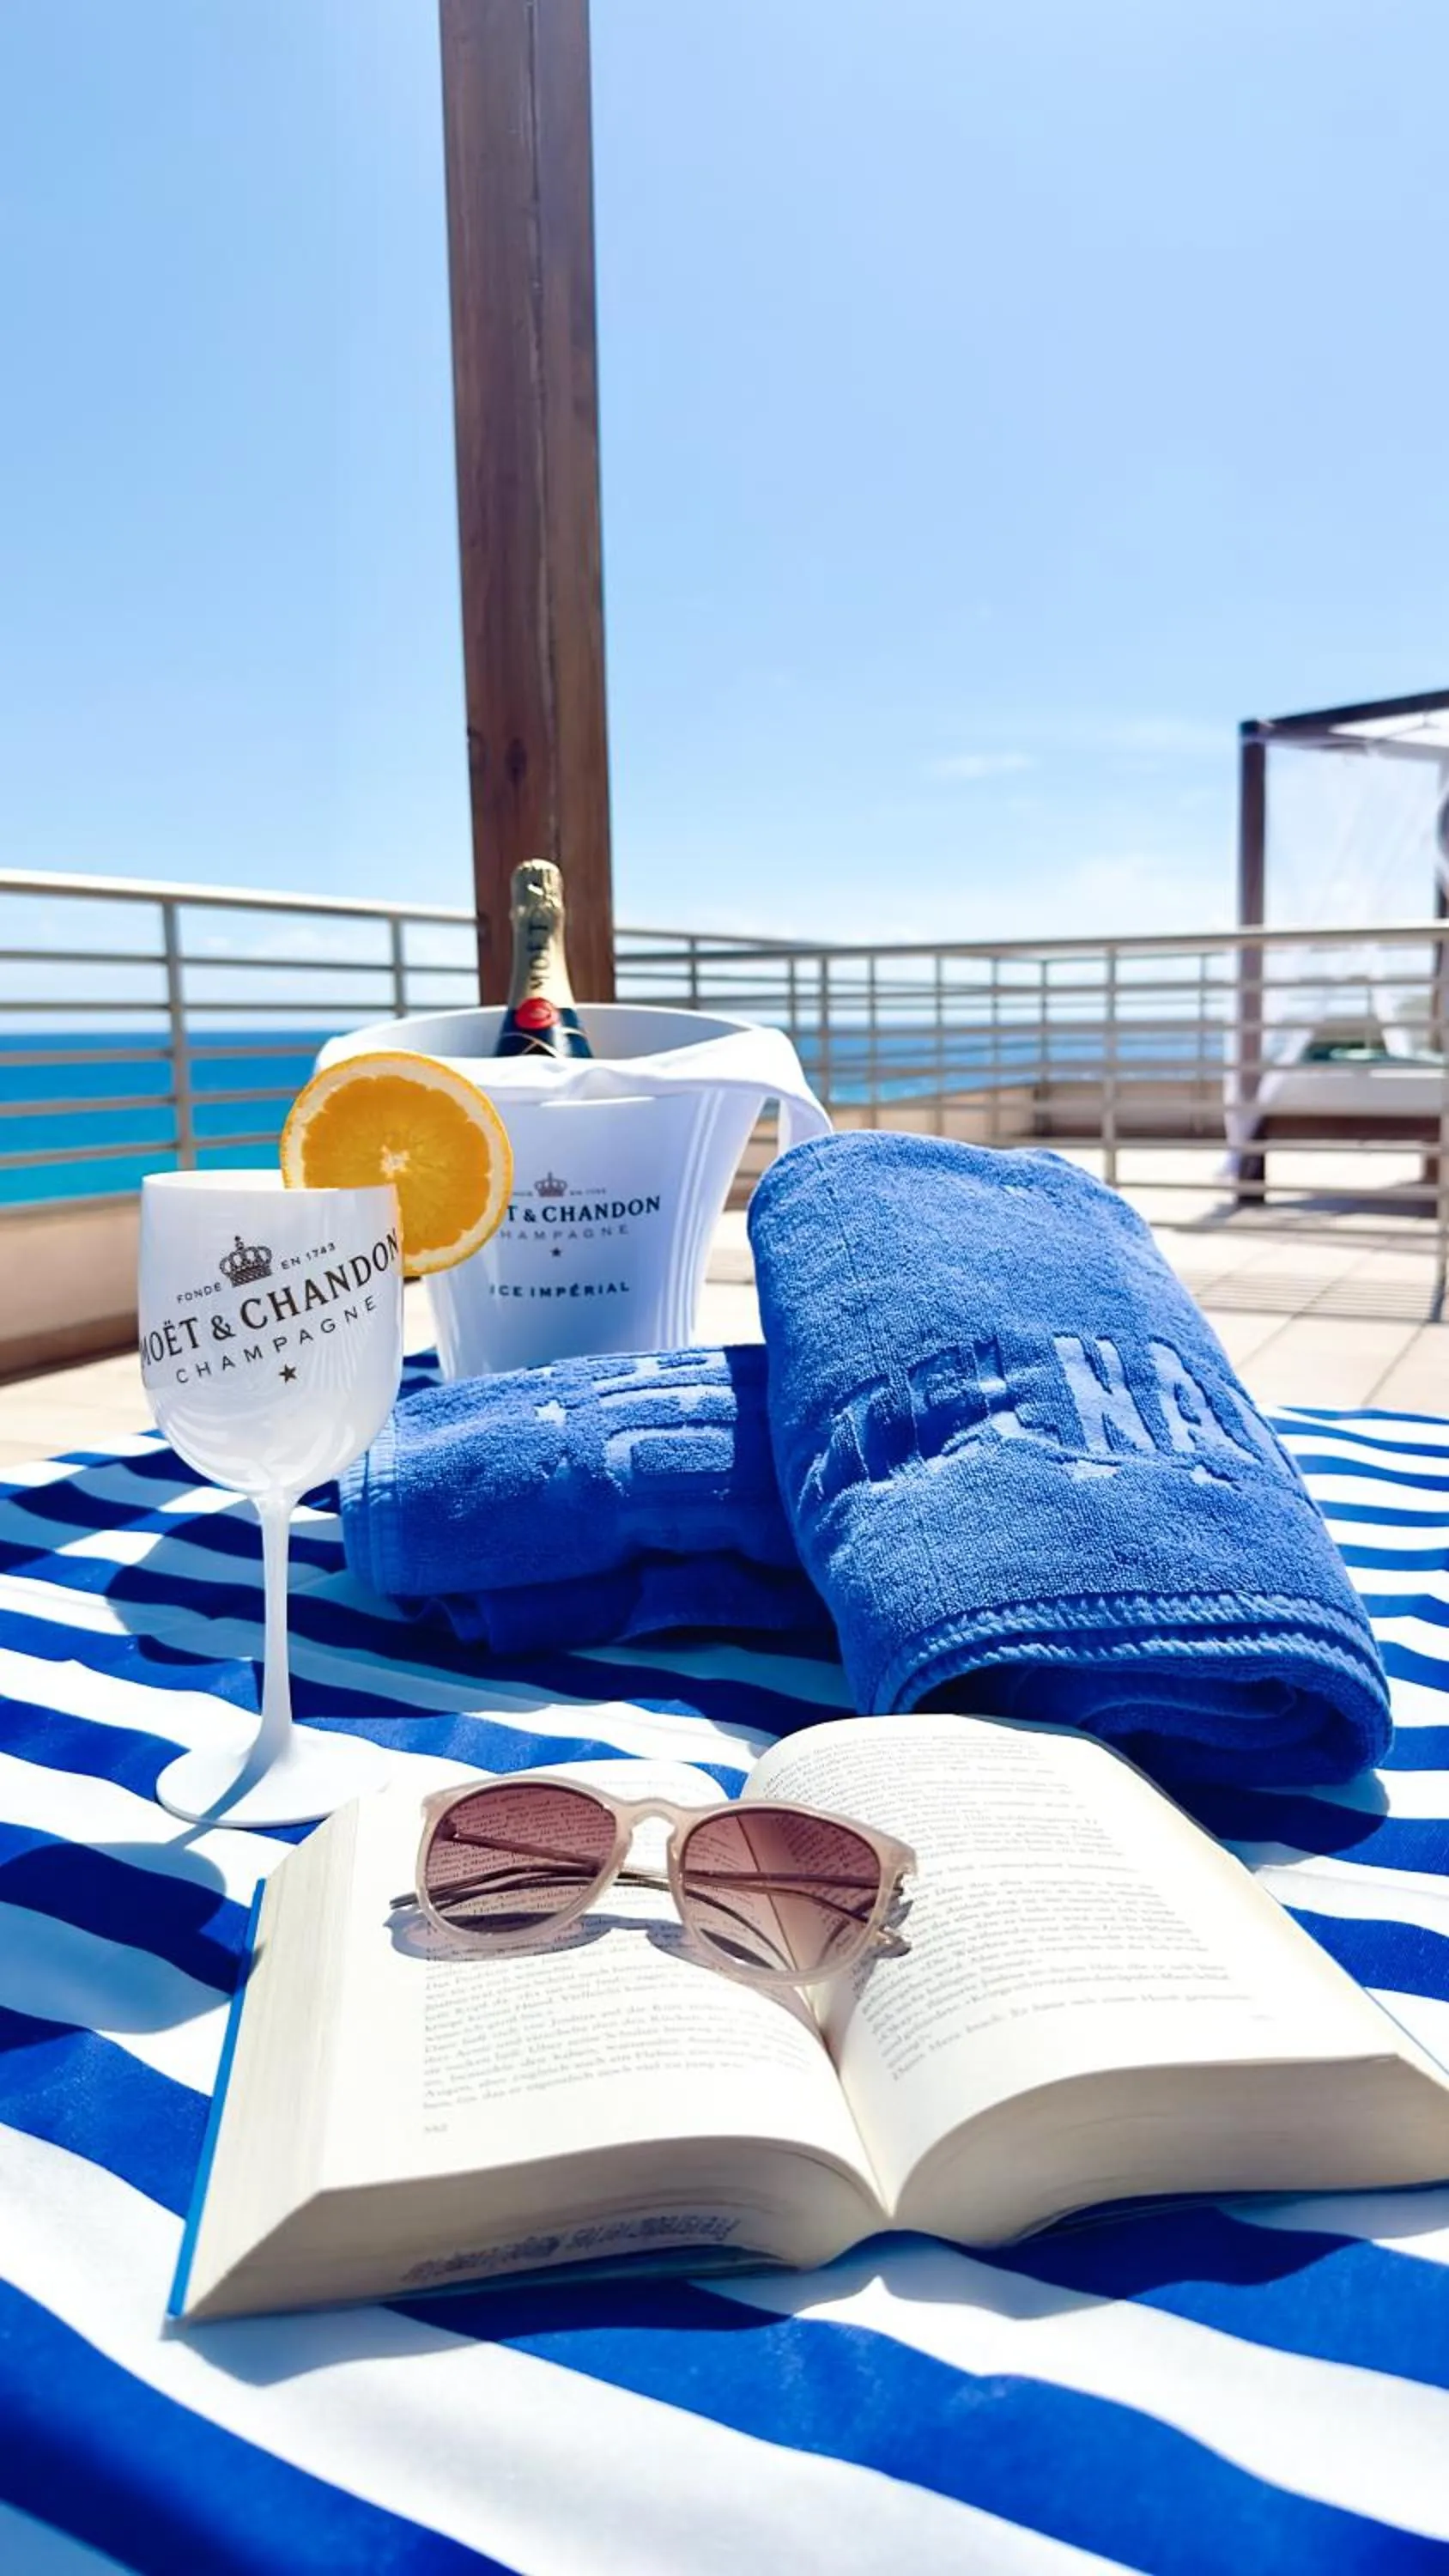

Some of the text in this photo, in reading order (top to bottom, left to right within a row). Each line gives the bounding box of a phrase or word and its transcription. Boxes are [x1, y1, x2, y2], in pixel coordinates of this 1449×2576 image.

[523, 1207, 537, 1224] &
[542, 1194, 661, 1224] CHANDON
[498, 1224, 629, 1241] HAMPAGNE
[281, 1256, 301, 1270] EN
[211, 1314, 236, 1342] &
[239, 1227, 399, 1331] CHANDON
[489, 1282, 630, 1298] ICE IMPÉRIAL
[175, 1294, 376, 1385] CHAMPAGNE
